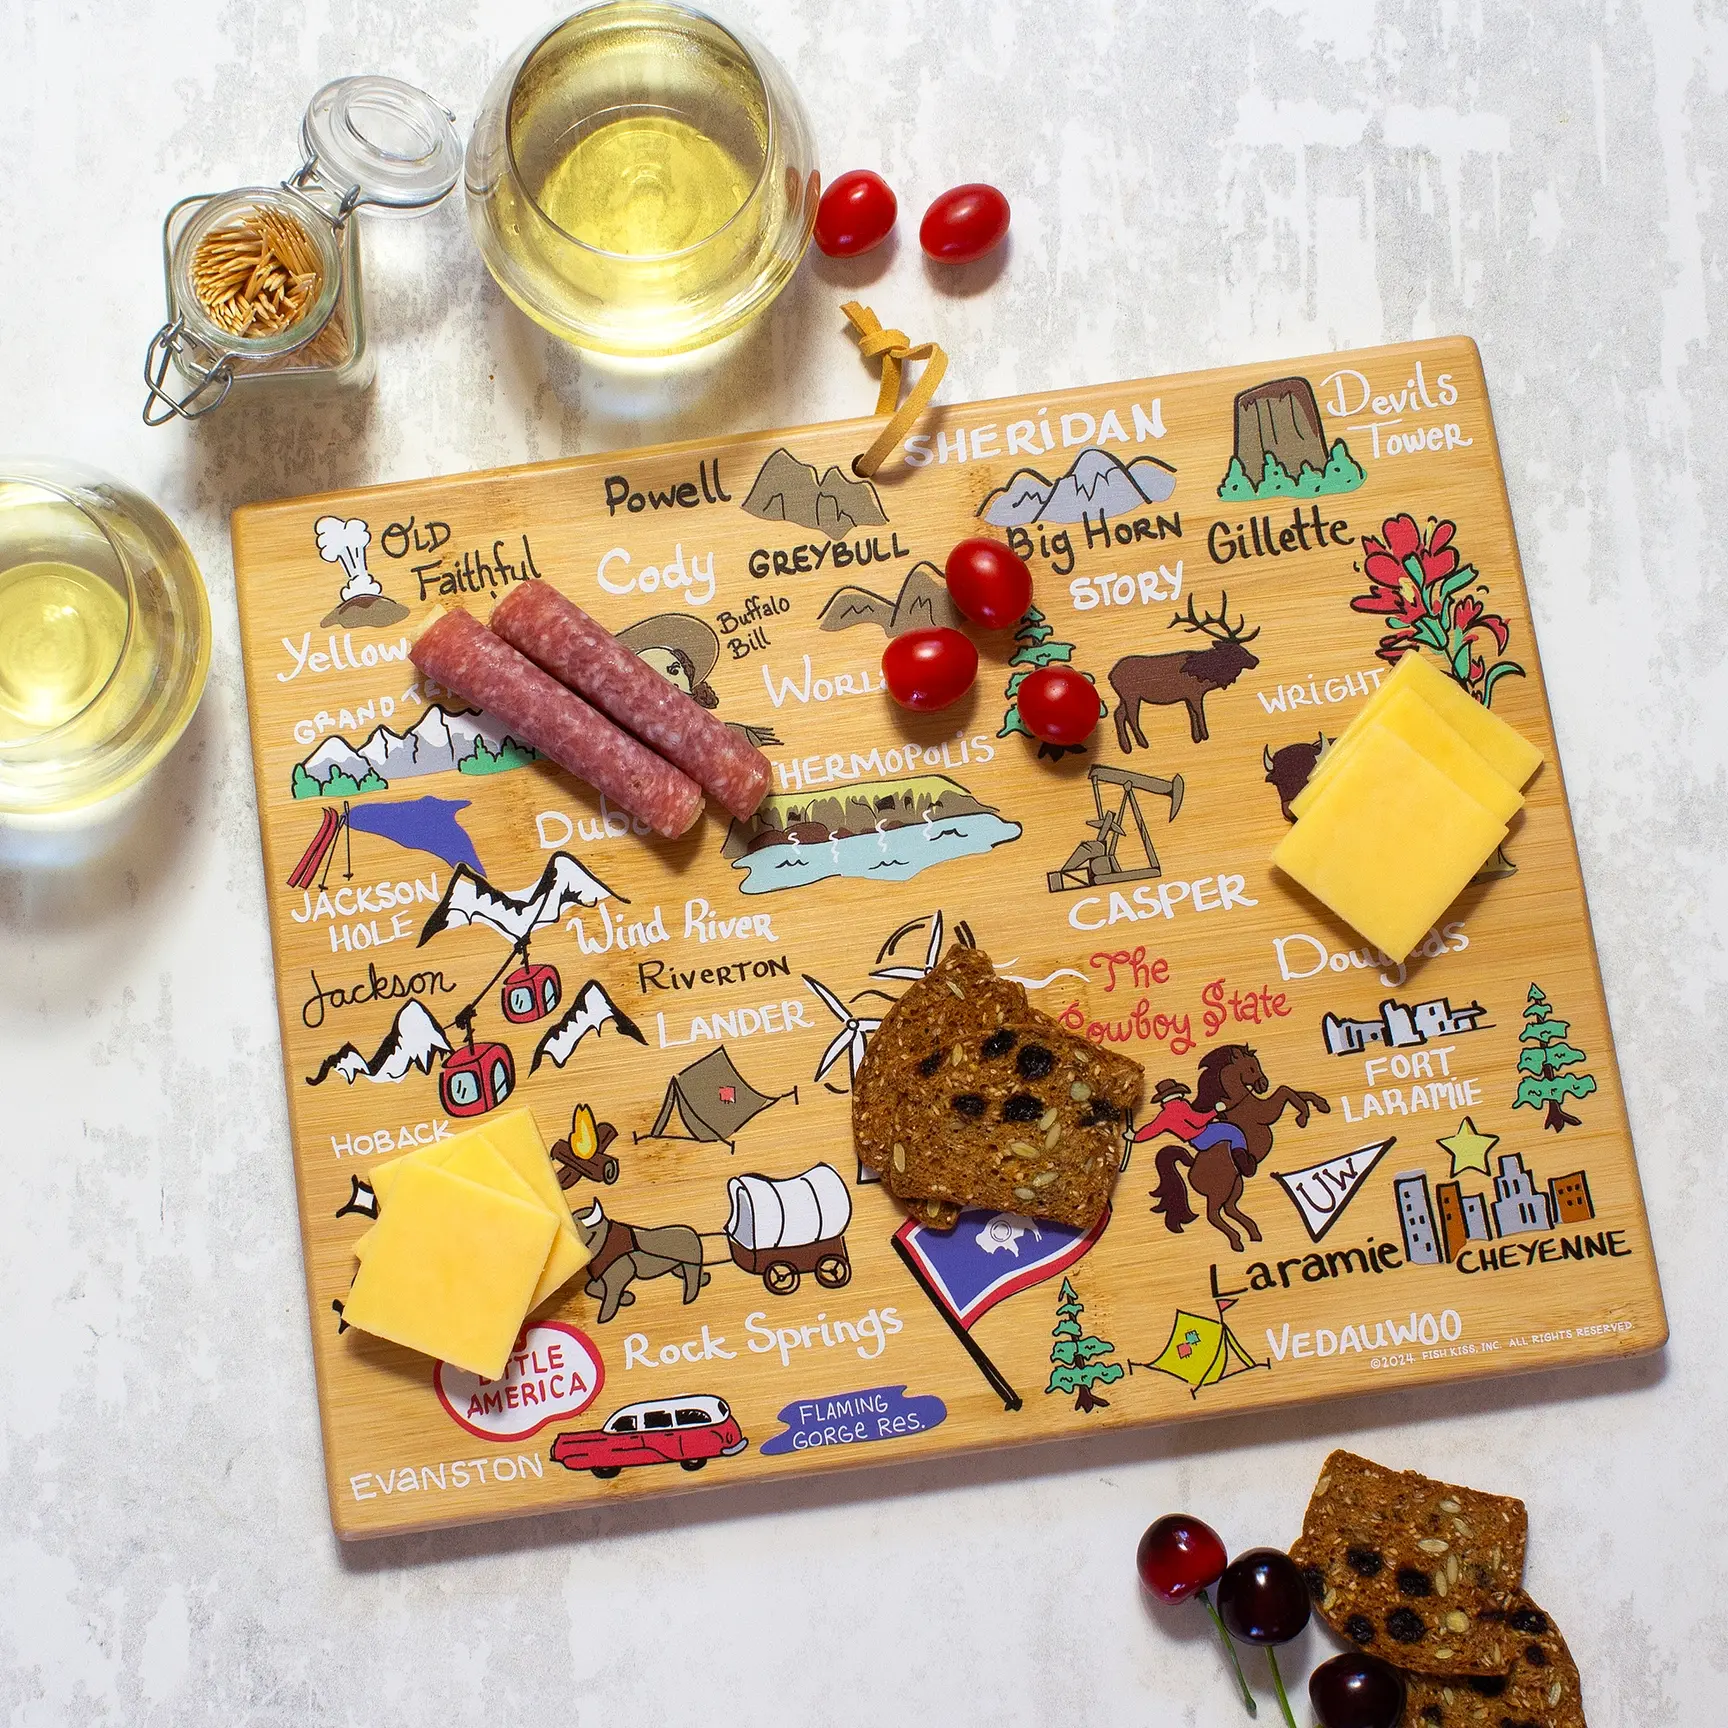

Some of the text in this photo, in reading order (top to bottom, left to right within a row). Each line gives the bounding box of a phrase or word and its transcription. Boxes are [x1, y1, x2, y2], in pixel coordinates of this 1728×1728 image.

[1320, 361, 1458, 417] Devils
[605, 460, 732, 515] Powell
[749, 533, 910, 578] GREYBULL
[1006, 507, 1182, 576] Big HORN
[1208, 505, 1355, 564] Gillette
[411, 534, 541, 601] Faithful
[597, 544, 714, 605] Cody
[1069, 560, 1183, 610] STORY
[717, 596, 790, 634] Buffalo
[727, 632, 771, 659] Bill
[294, 696, 394, 745] GRAND
[291, 872, 440, 923] JACKSON
[1068, 873, 1258, 932] CASPER
[329, 910, 413, 952] HOLE
[566, 903, 670, 955] Wind
[1089, 945, 1170, 993] The
[303, 962, 457, 1028] Jackson
[1201, 977, 1292, 1038] State
[657, 1000, 815, 1049] LANDER
[1365, 1045, 1456, 1087] FORT
[331, 1119, 455, 1160] HOBACK
[1296, 1157, 1358, 1214] UW
[1209, 1236, 1406, 1299] Laramie
[1455, 1229, 1632, 1275] CHEYENNE
[623, 1307, 904, 1370] Rock Springs
[1265, 1308, 1462, 1362] VEDAUWOO
[1422, 1347, 1448, 1361] FISH
[1450, 1343, 1479, 1358] KISS,
[1481, 1340, 1503, 1352] INC.
[1508, 1335, 1529, 1348] ALL
[1531, 1329, 1573, 1344] RIGHTS
[1575, 1320, 1636, 1337] RESERVED.
[467, 1371, 588, 1419] AMERICA
[799, 1394, 888, 1425] FLAMING
